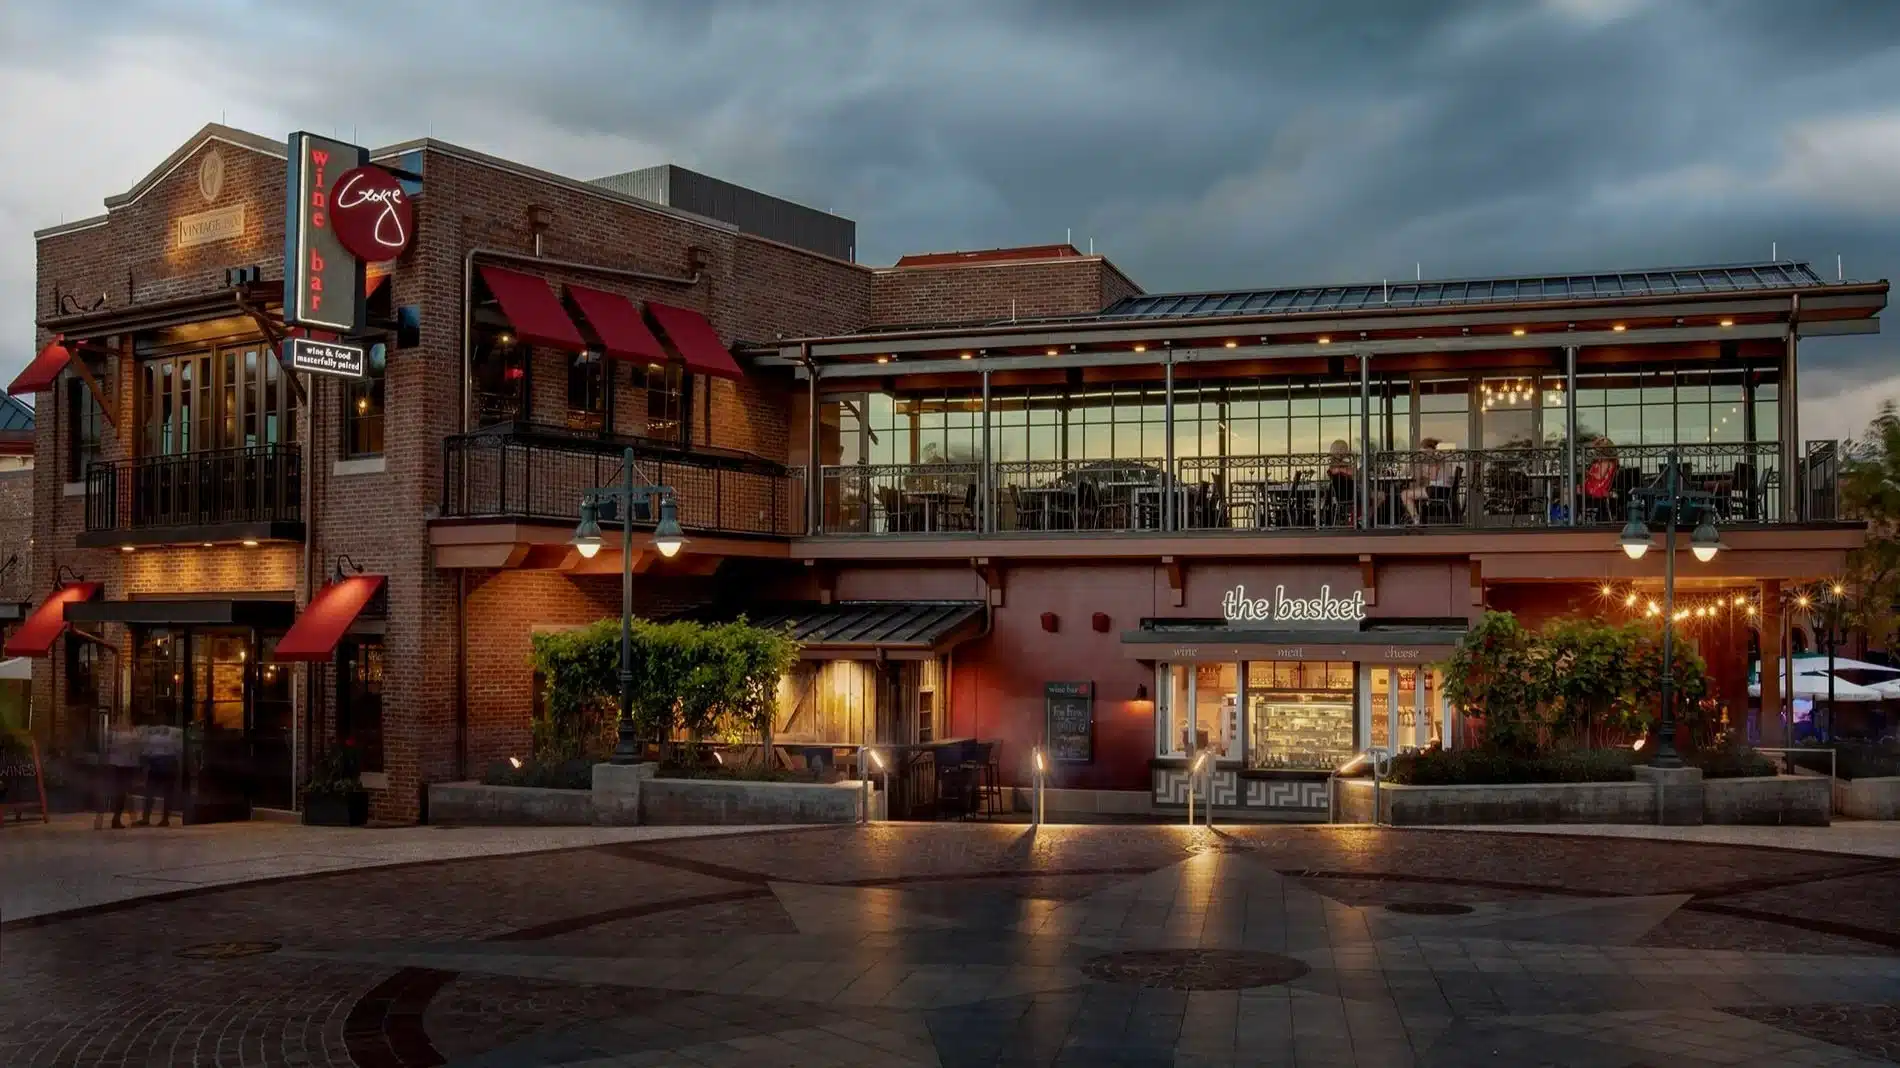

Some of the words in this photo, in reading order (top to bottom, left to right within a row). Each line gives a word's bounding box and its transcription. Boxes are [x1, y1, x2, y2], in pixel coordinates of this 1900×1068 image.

[310, 149, 329, 228] wine
[338, 174, 405, 247] George
[183, 219, 221, 236] VINTAGE
[310, 248, 324, 312] bar
[297, 355, 337, 368] masterfully
[338, 362, 360, 371] paired
[306, 347, 324, 356] wine
[325, 348, 334, 357] &
[335, 350, 351, 360] food
[1221, 584, 1269, 620] the
[1274, 584, 1366, 621] basket
[1173, 647, 1198, 657] wine
[1277, 648, 1304, 658] meat
[1385, 646, 1420, 659] cheese
